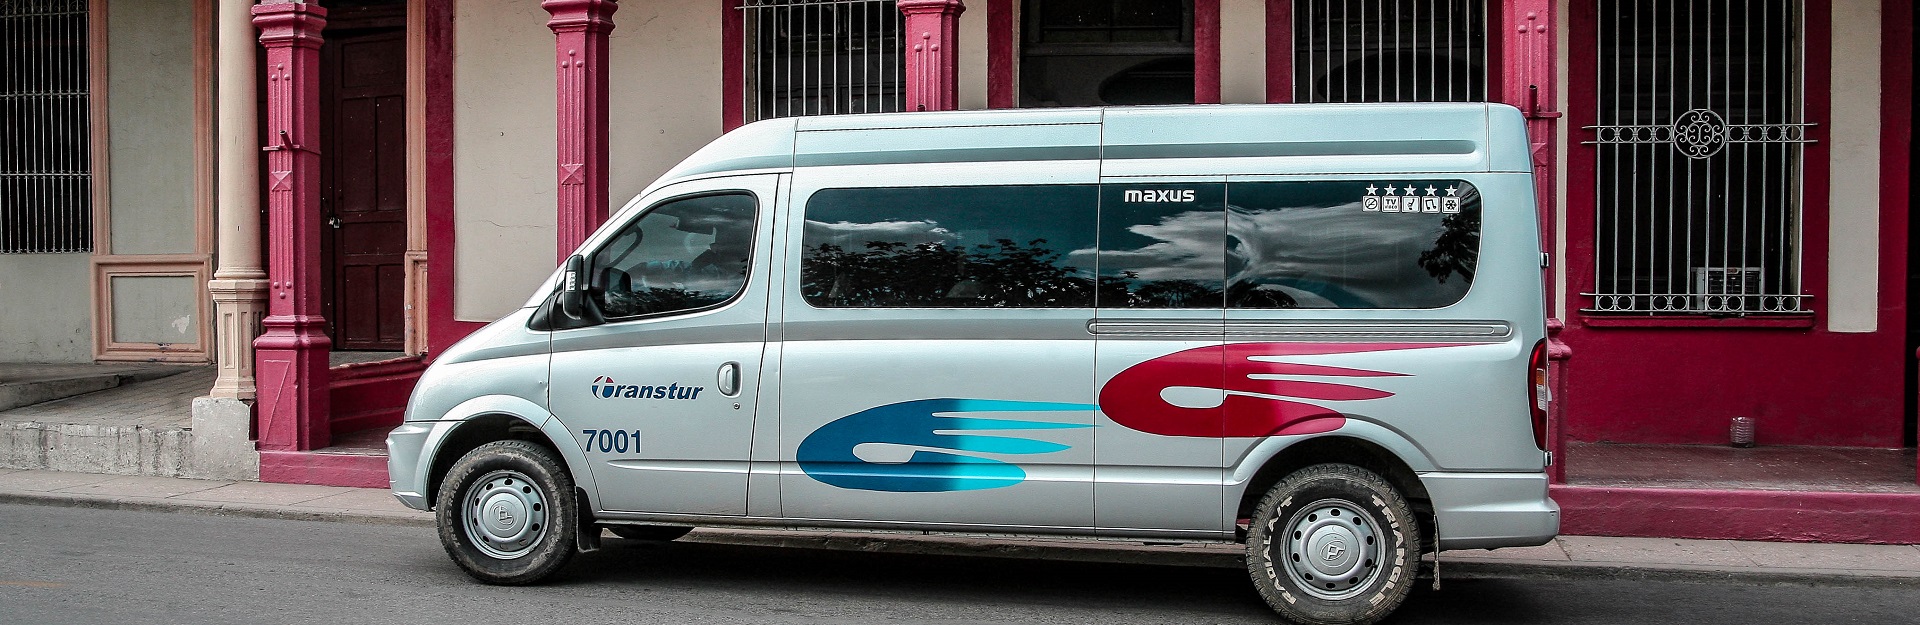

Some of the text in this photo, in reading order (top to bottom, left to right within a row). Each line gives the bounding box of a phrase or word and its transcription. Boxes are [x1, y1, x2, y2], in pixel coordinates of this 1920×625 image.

[1124, 189, 1195, 202] maxus
[582, 429, 641, 453] 7001
[1263, 536, 1297, 605] RADIAL
[1371, 494, 1404, 606] TRIANGLE
